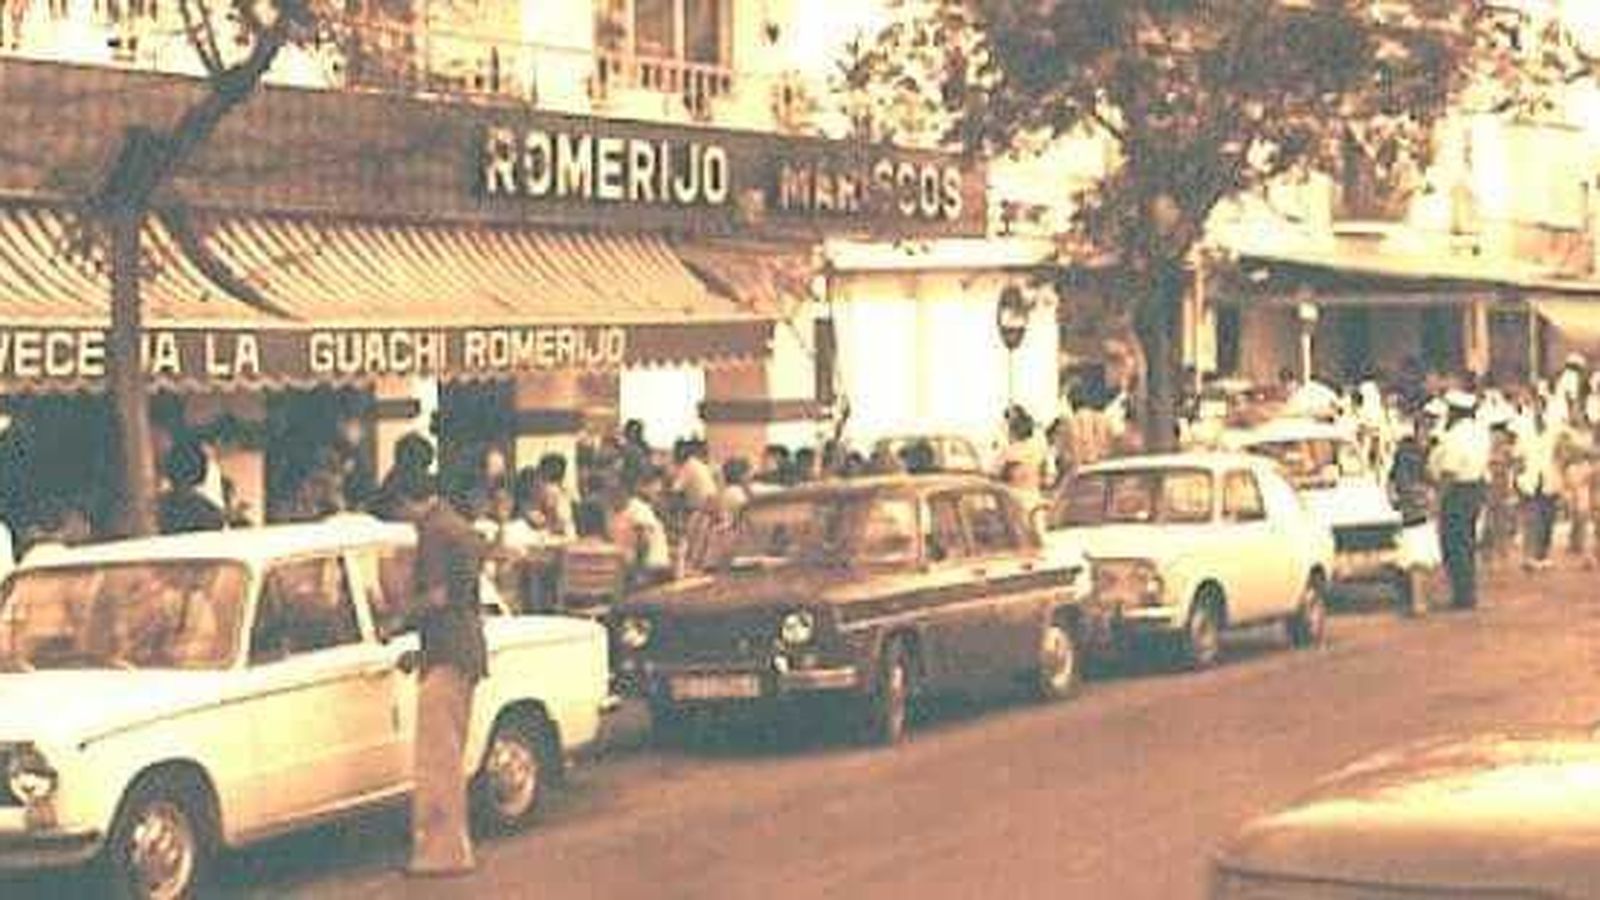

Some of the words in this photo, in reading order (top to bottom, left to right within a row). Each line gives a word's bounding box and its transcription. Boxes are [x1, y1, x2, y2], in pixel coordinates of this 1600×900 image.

[486, 130, 728, 203] ROMERIJO
[206, 331, 259, 375] LA
[310, 330, 446, 373] GUACHI
[465, 327, 626, 368] ROMERIJO
